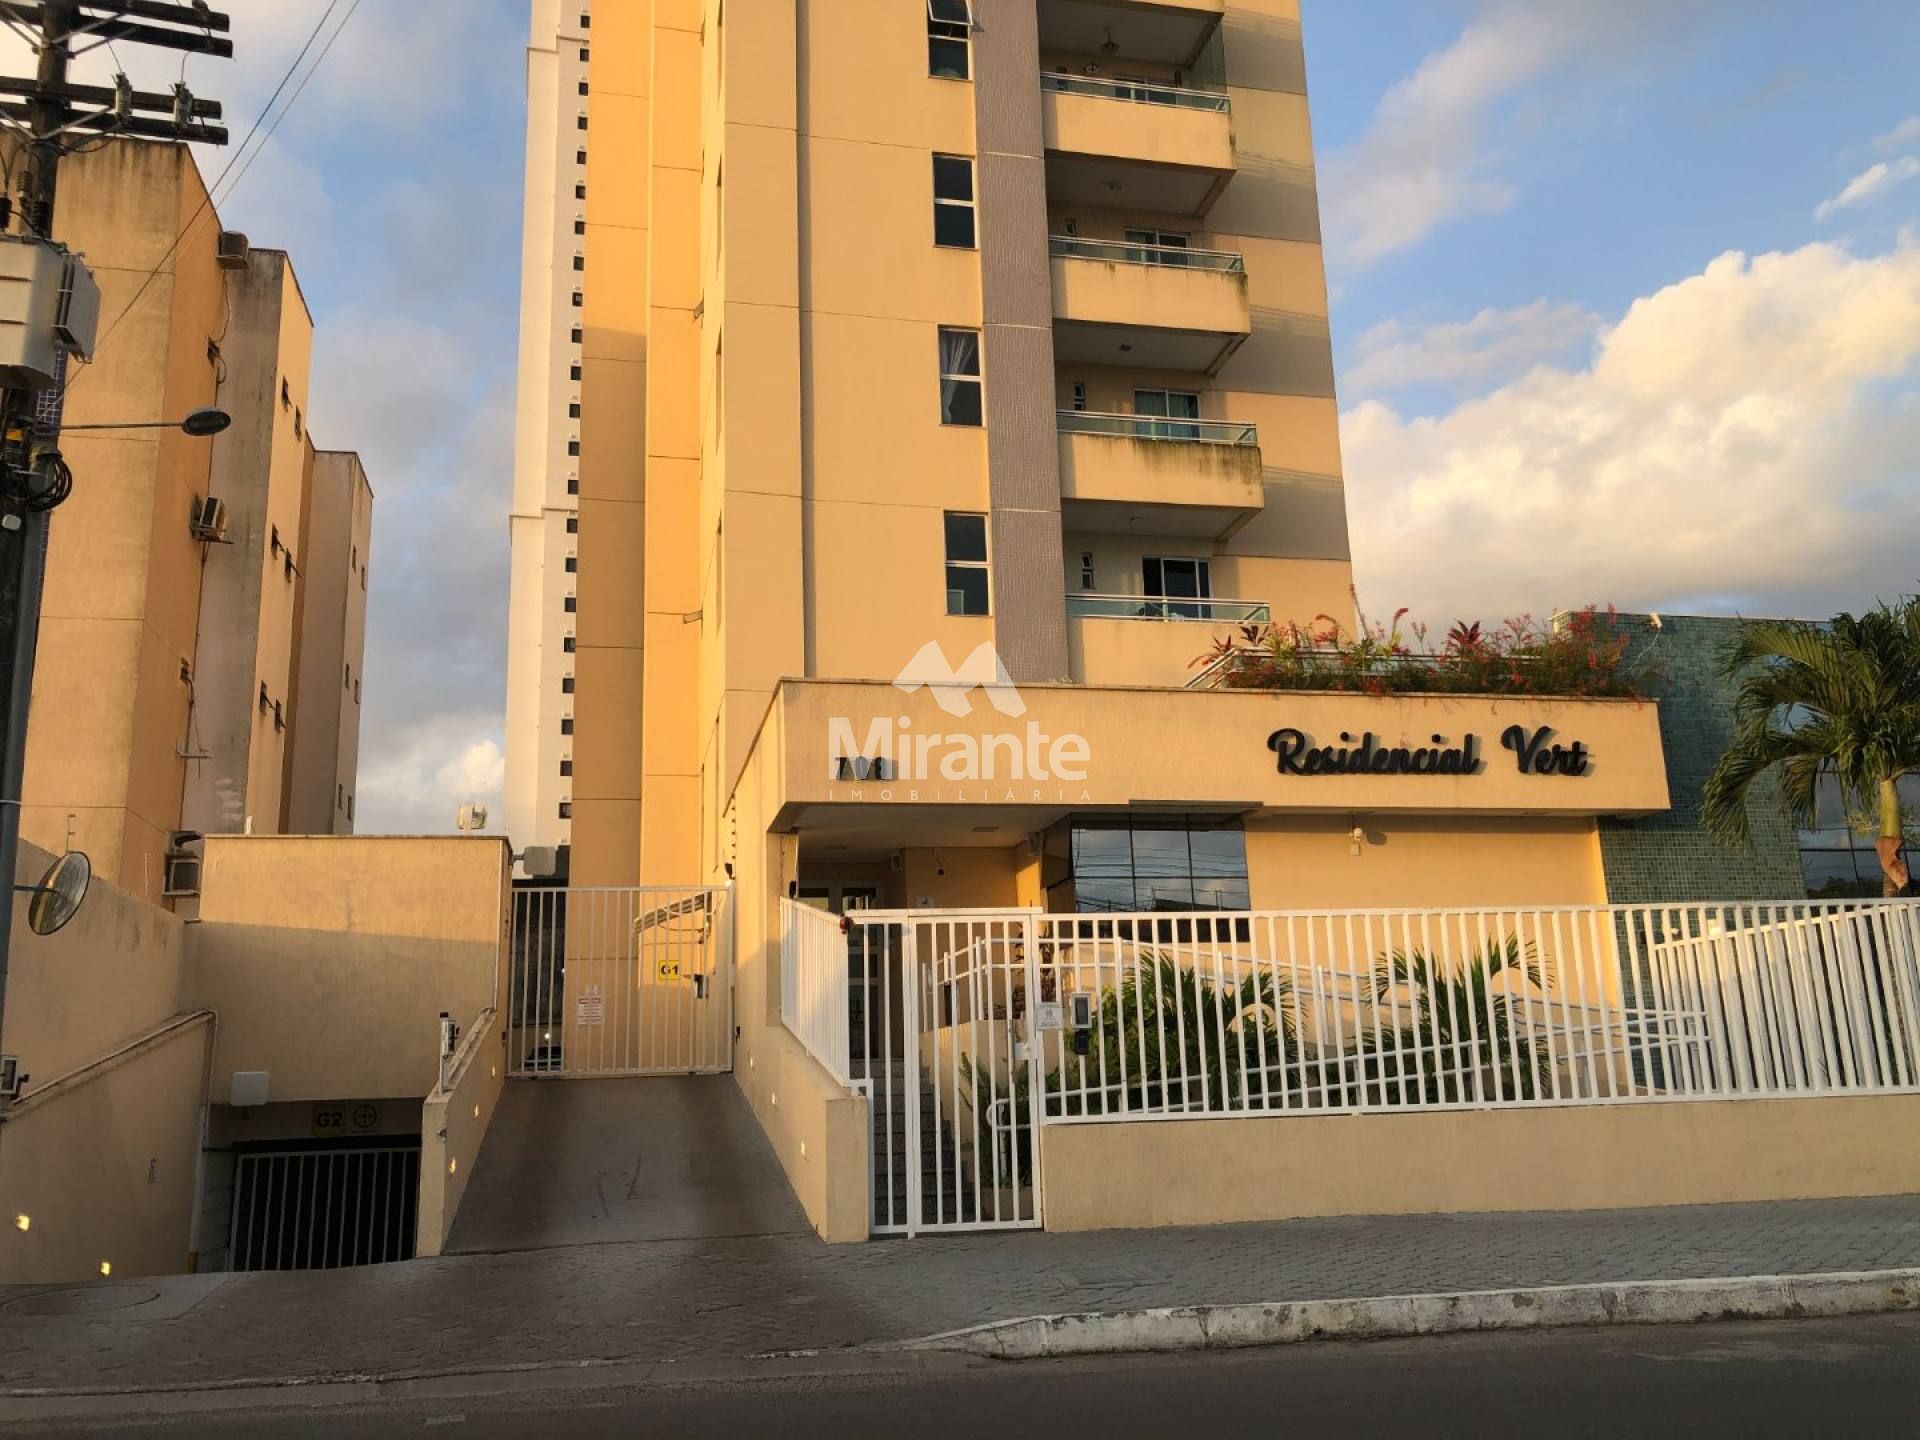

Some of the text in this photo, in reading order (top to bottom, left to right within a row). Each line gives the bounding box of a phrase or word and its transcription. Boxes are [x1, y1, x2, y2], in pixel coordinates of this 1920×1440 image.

[1267, 725, 1589, 776] Residencial Vert
[660, 964, 679, 975] G1
[316, 1111, 343, 1128] G2
